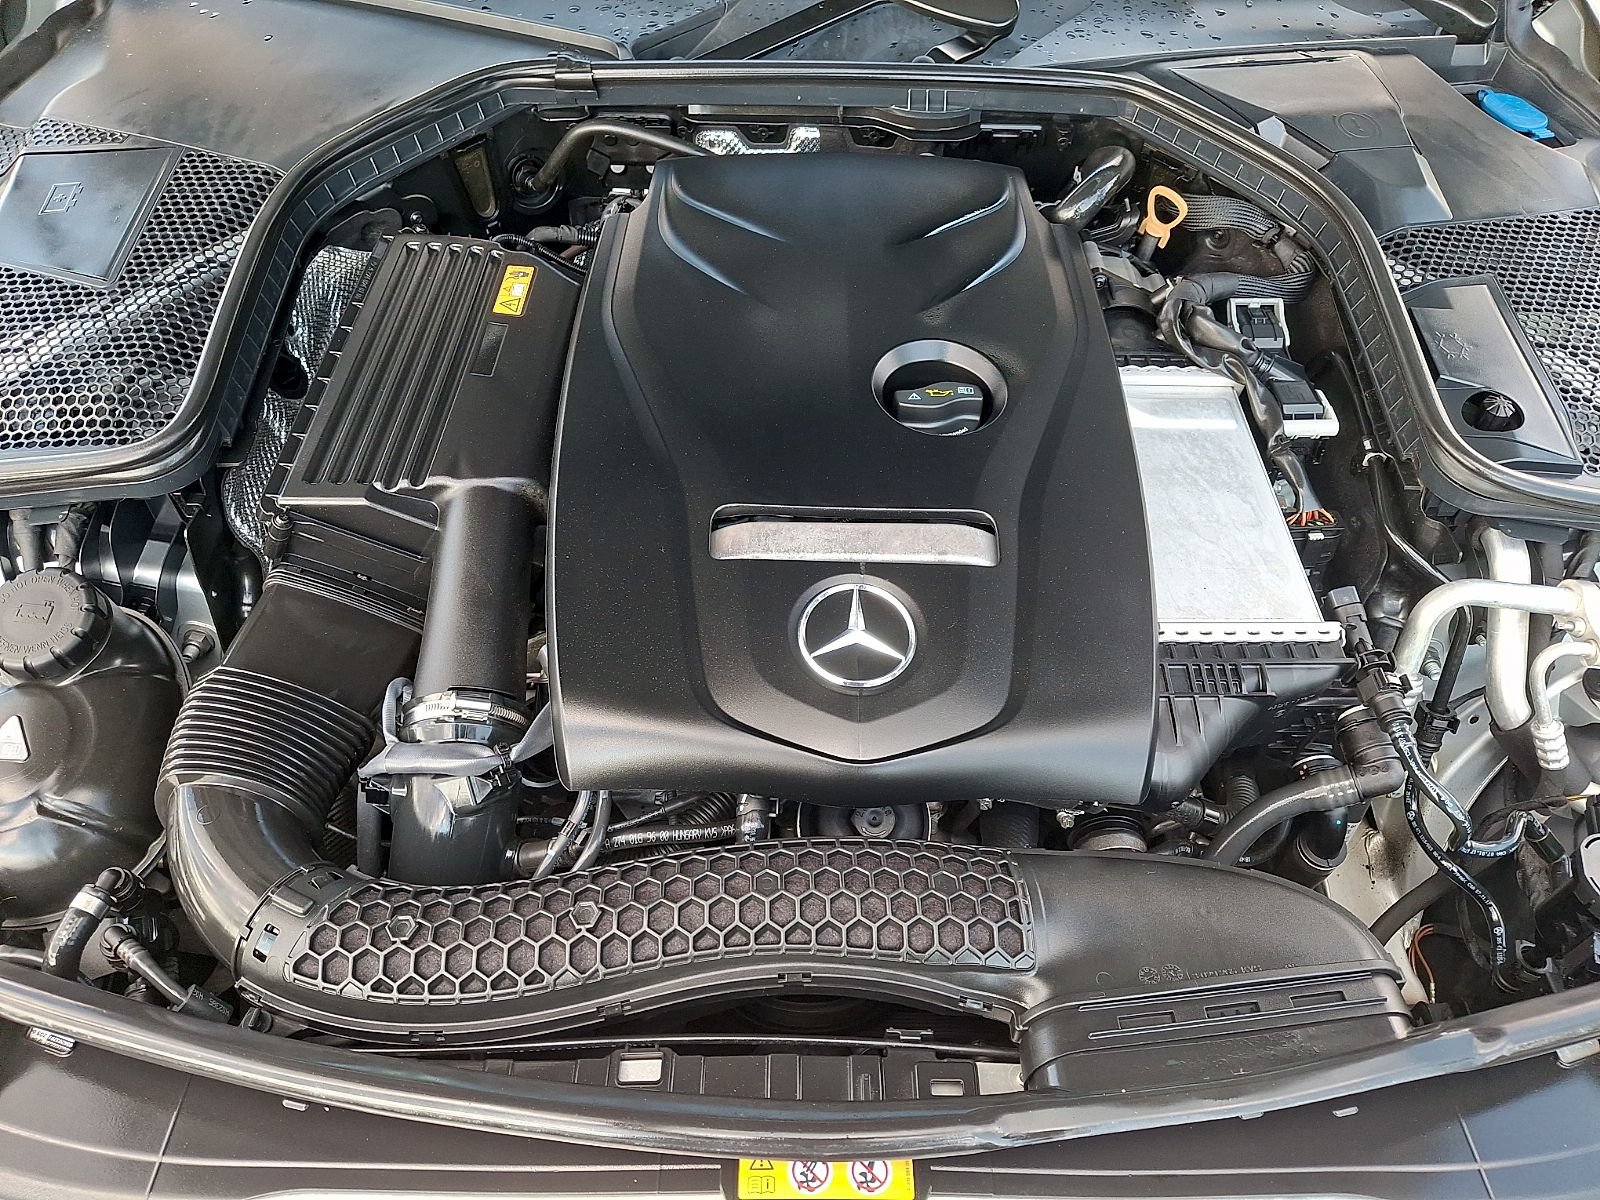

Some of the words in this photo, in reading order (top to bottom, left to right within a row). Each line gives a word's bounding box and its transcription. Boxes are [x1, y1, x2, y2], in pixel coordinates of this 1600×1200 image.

[31, 575, 55, 584] OPEN
[23, 640, 50, 653] WENN
[50, 622, 72, 642] HEISS
[612, 835, 627, 848] 274
[646, 831, 657, 843] 96
[659, 830, 670, 841] 00
[672, 828, 702, 842] HUNGARY
